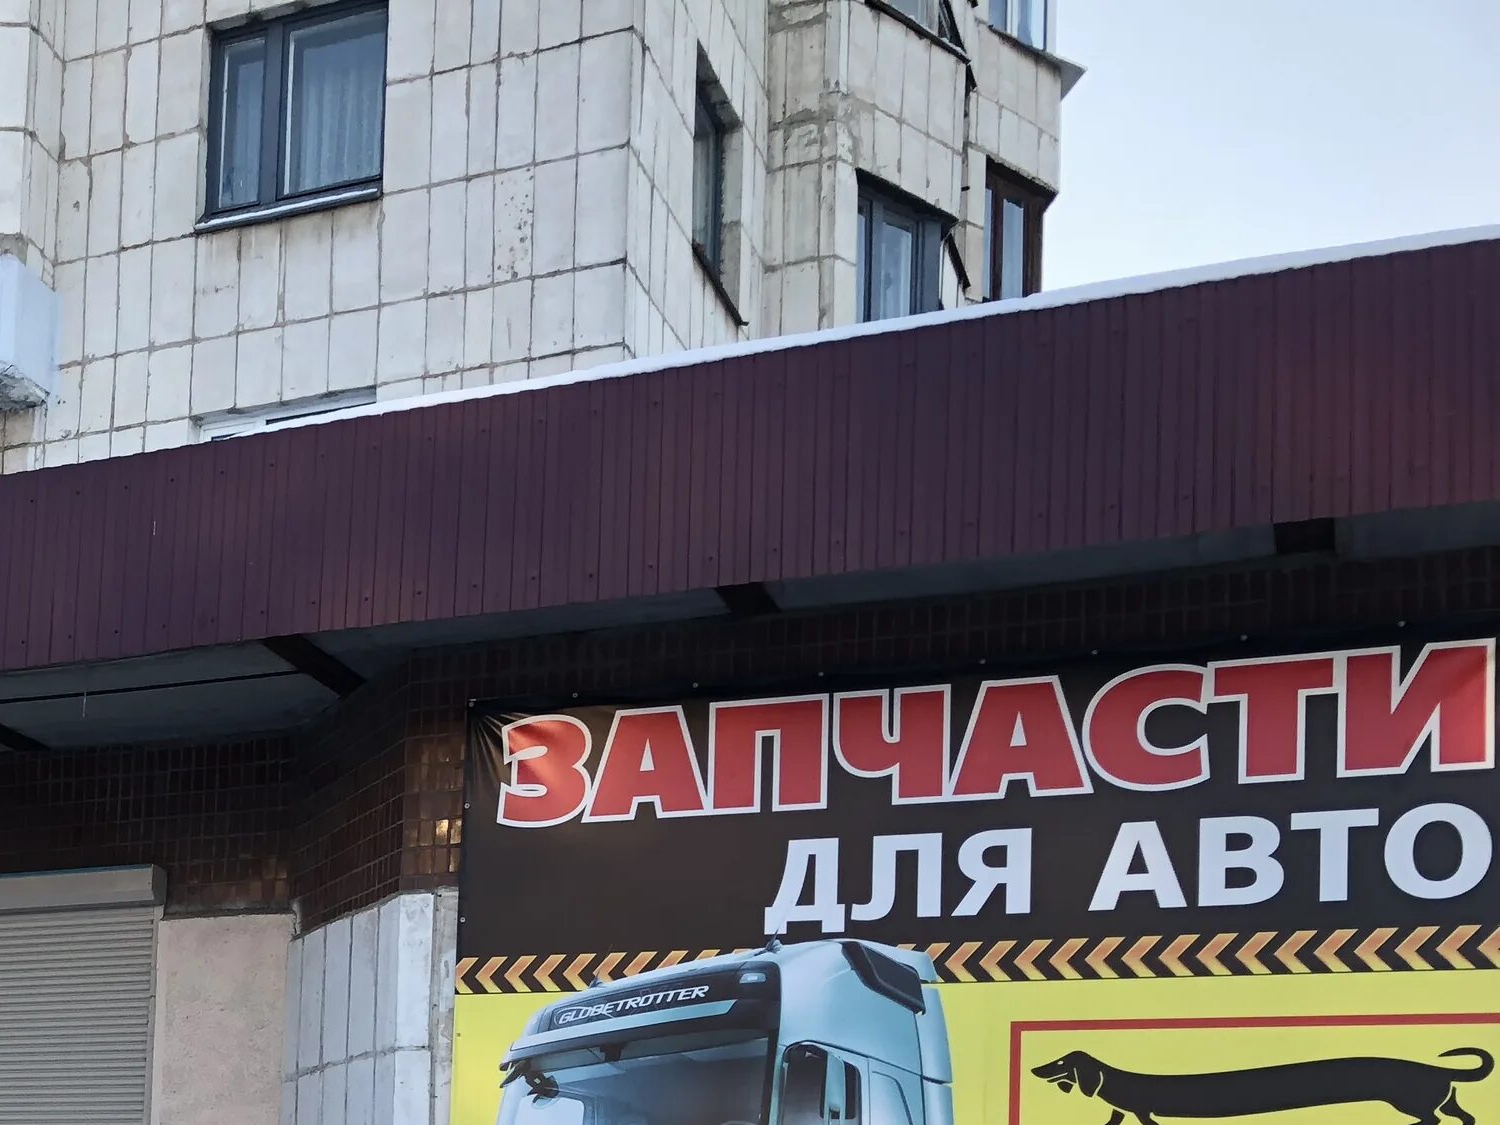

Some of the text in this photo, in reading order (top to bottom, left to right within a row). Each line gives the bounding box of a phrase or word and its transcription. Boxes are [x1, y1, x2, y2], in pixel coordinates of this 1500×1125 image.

[496, 637, 1497, 828] ЗАПЧАСТИ
[764, 802, 1493, 935] ДЛЯ АВТО
[558, 985, 709, 1025] GLOBETROTTER
